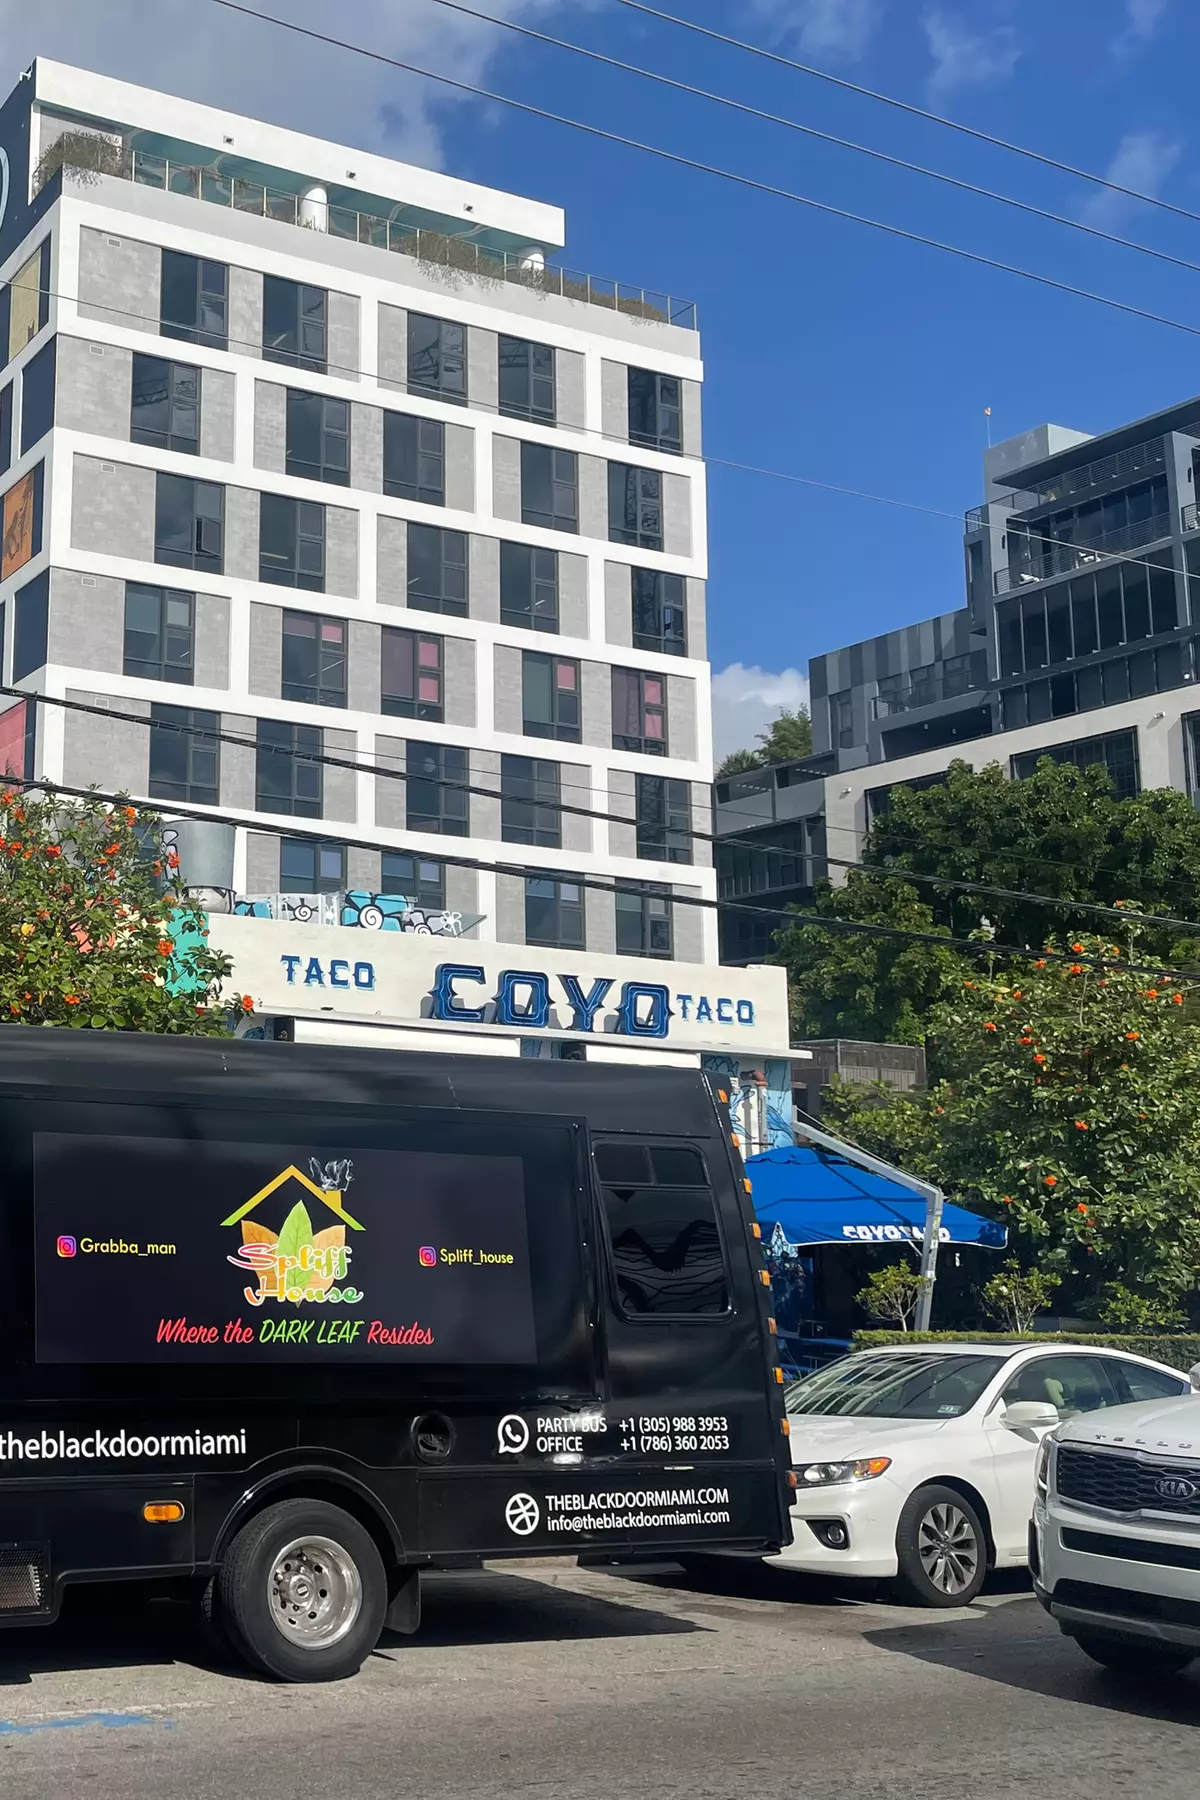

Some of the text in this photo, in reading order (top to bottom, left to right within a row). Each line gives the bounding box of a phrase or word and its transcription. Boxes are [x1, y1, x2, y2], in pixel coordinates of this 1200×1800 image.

[280, 954, 377, 992] TACO
[427, 962, 676, 1039] COYO
[676, 993, 756, 1027] TACO
[80, 1237, 177, 1257] Grabba_man
[440, 1247, 515, 1266] Spliff_house
[226, 1242, 353, 1281] Spliff
[243, 1275, 365, 1307] House
[156, 1317, 435, 1346] Where the DARK LEAF Resides
[536, 1416, 728, 1435] PARTY BUS +1 (305) 988 3953
[536, 1435, 730, 1453] OFFICE +1 (786) 360 2053
[545, 1488, 729, 1512] THEBLACKDOORMIAMI.COM
[1160, 1480, 1188, 1496] KIA
[547, 1509, 730, 1532] info@theblackdoormiami.com
